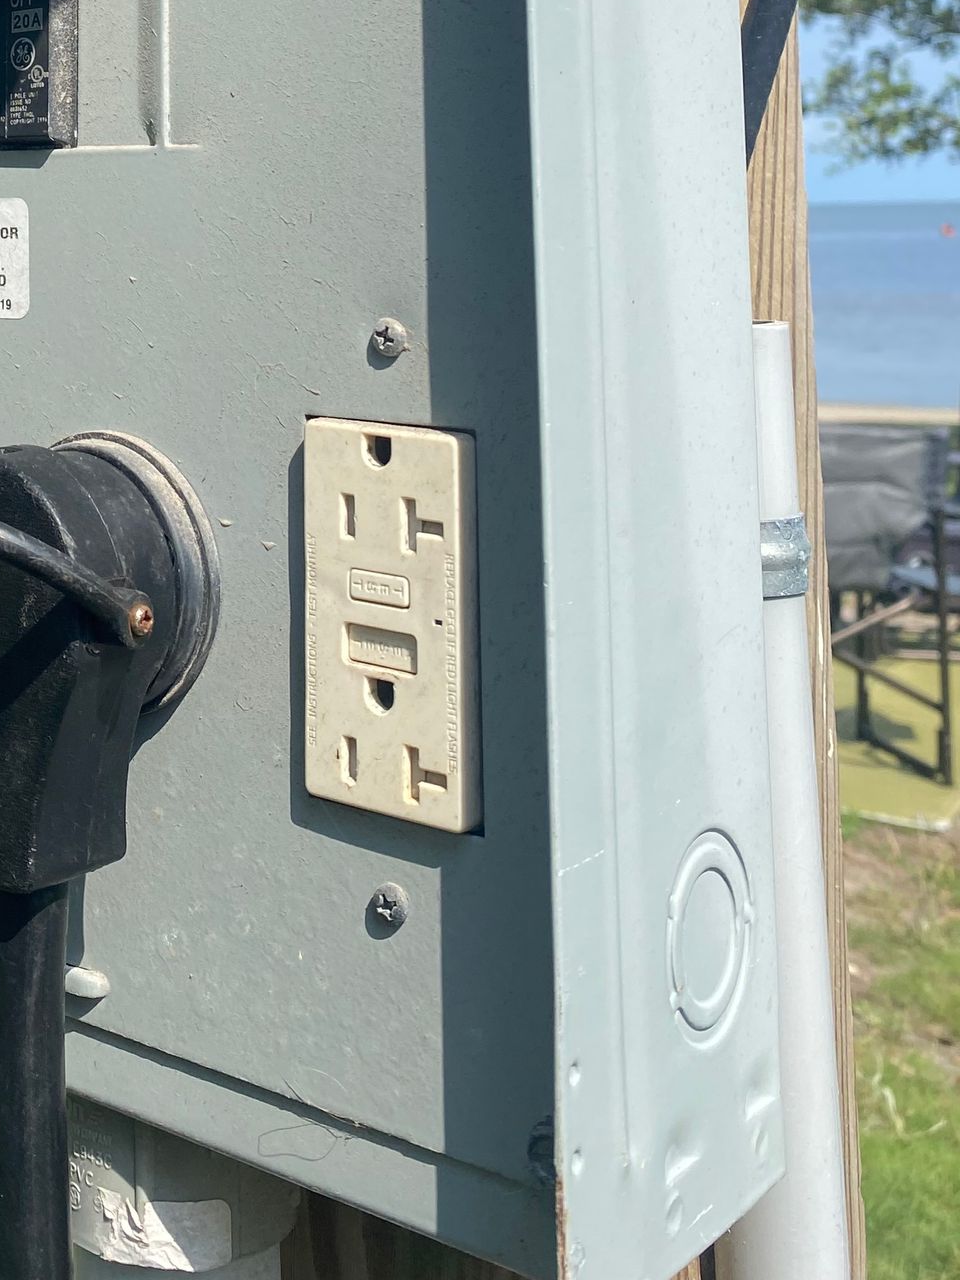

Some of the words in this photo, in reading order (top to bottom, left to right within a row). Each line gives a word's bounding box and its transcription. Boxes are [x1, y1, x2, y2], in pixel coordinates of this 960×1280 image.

[13, 13, 40, 30] 20A
[0, 226, 18, 239] OR
[308, 533, 317, 588] MONTHLY
[352, 578, 404, 598] TEST
[445, 553, 456, 609] REPLACE
[308, 591, 318, 617] TEST
[308, 634, 318, 720] INSTRUCTIONS
[446, 654, 456, 679] RED
[446, 680, 457, 717] LIGHT
[70, 1161, 94, 1186] PVC
